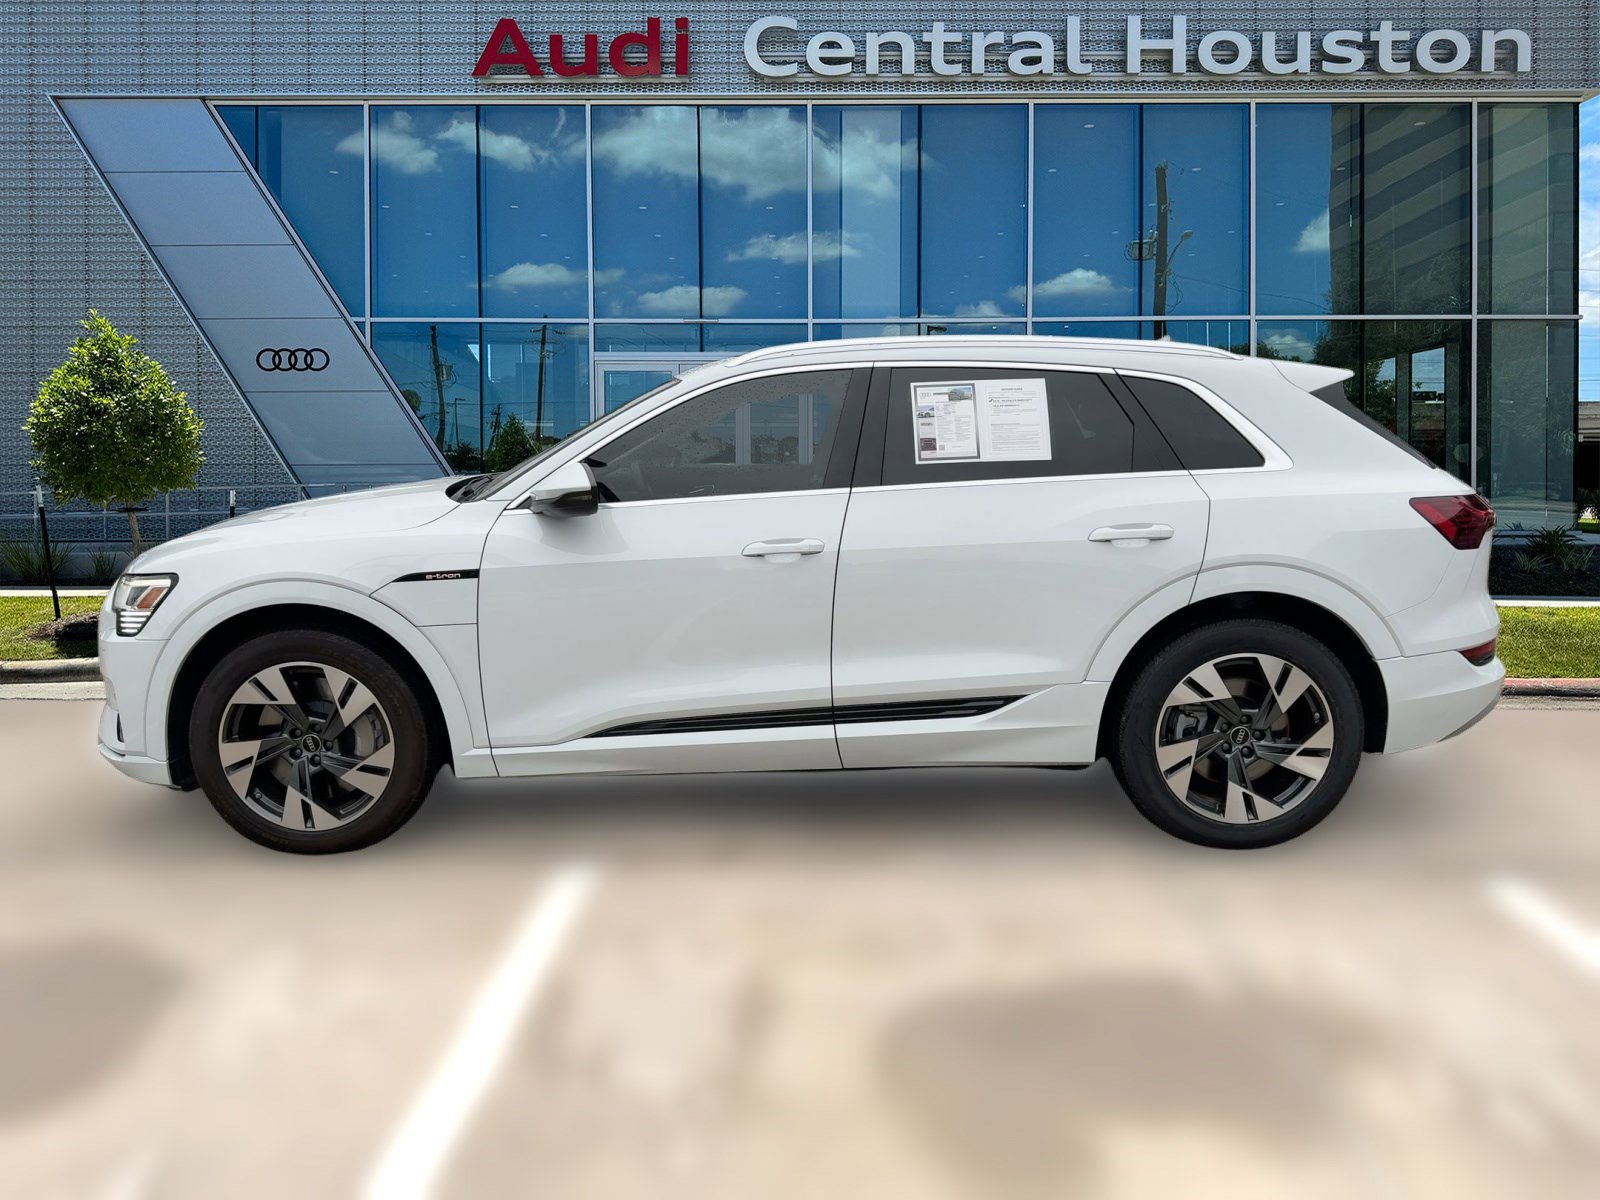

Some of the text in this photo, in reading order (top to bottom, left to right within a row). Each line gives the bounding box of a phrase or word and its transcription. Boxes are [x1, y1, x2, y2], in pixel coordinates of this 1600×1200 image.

[472, 15, 1532, 77] Audi Central Houston
